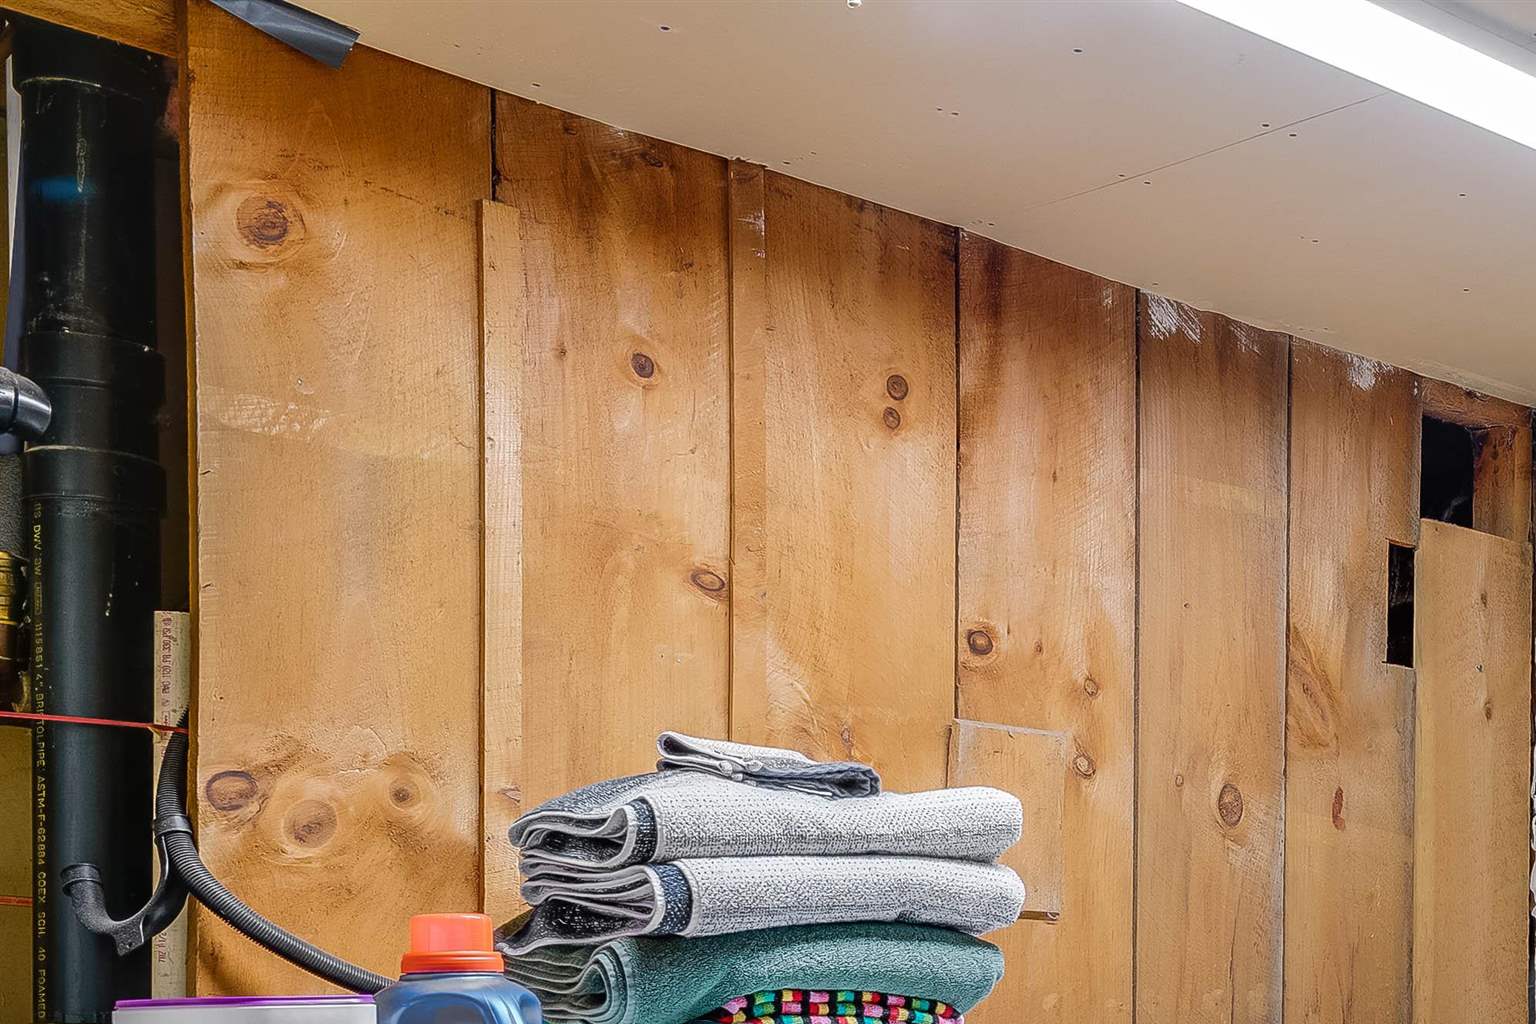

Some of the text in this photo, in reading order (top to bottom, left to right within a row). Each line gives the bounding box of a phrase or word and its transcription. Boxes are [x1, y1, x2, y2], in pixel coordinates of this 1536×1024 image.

[36, 693, 47, 768] BRITOLPIPE
[37, 871, 47, 904] COEX
[37, 969, 47, 1019] FOAMED
